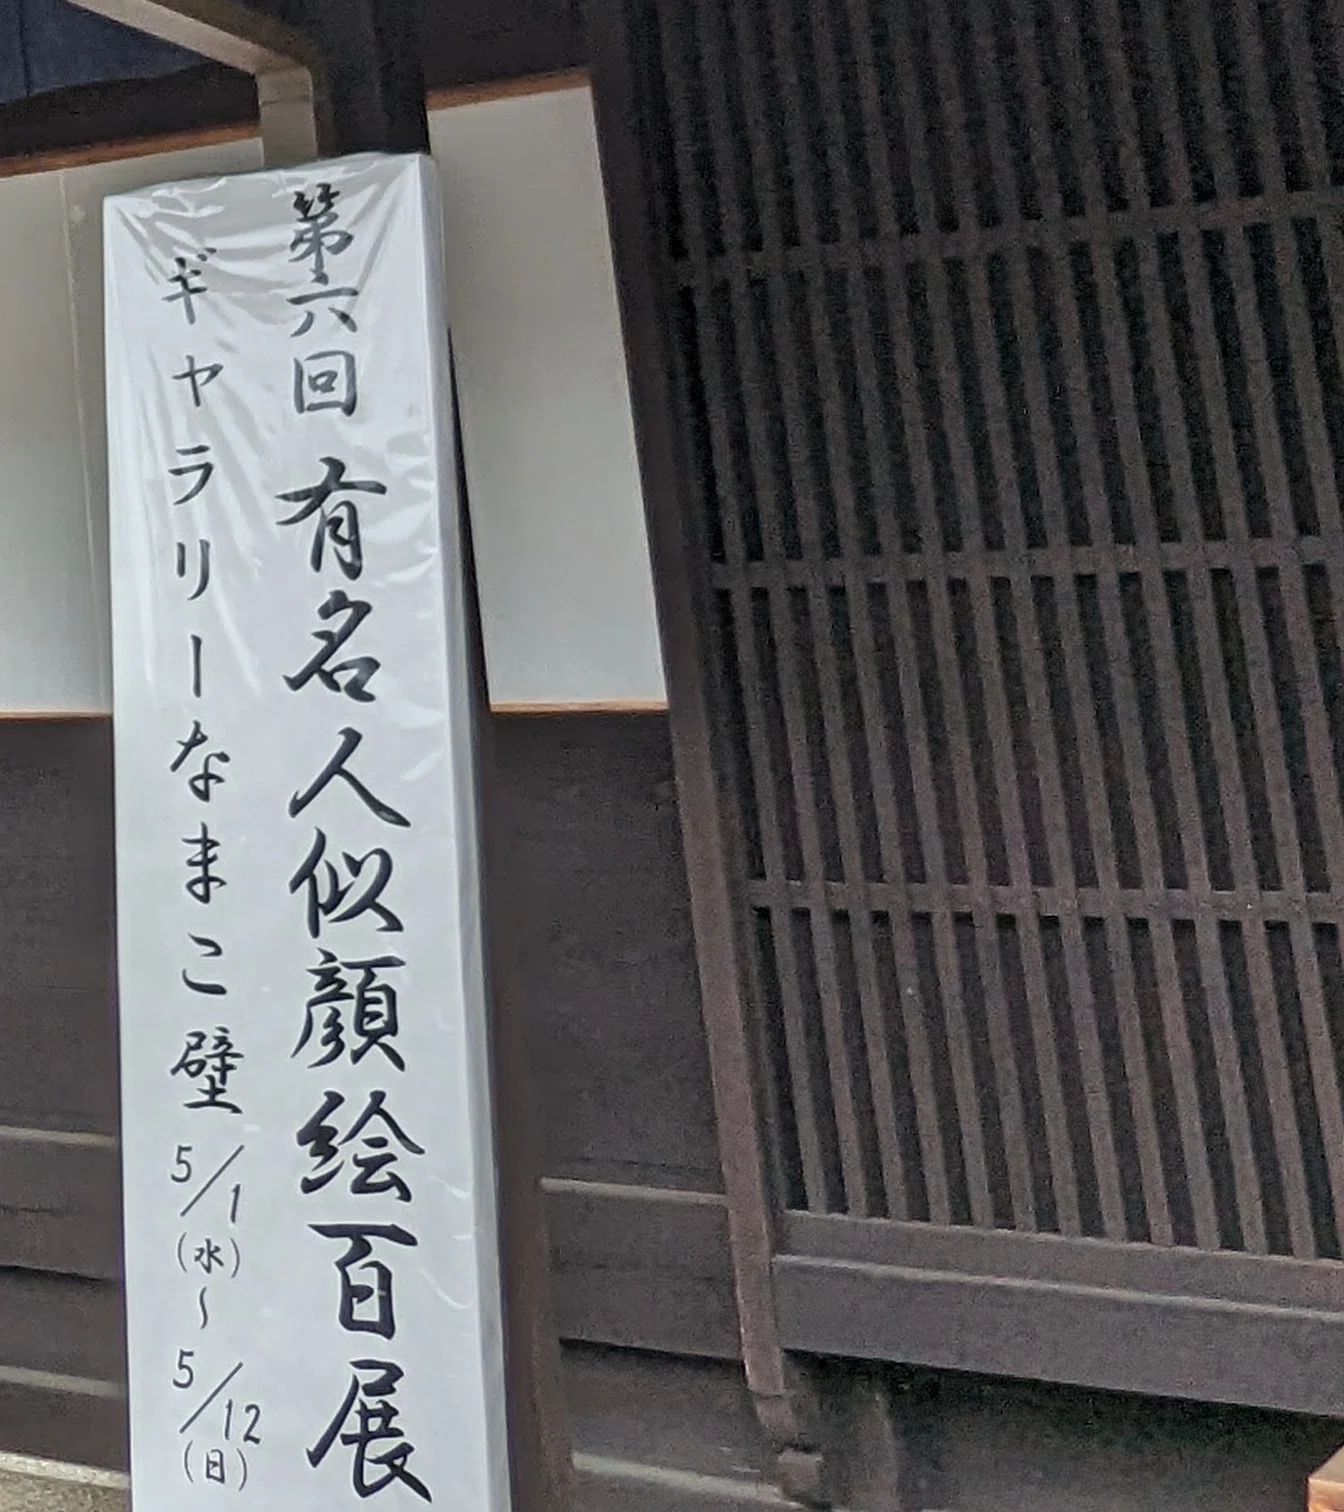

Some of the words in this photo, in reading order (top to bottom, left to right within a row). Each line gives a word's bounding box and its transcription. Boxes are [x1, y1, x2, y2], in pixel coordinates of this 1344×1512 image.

[286, 183, 359, 416] 第六回
[276, 456, 432, 1503] 有名人似顔絵百展
